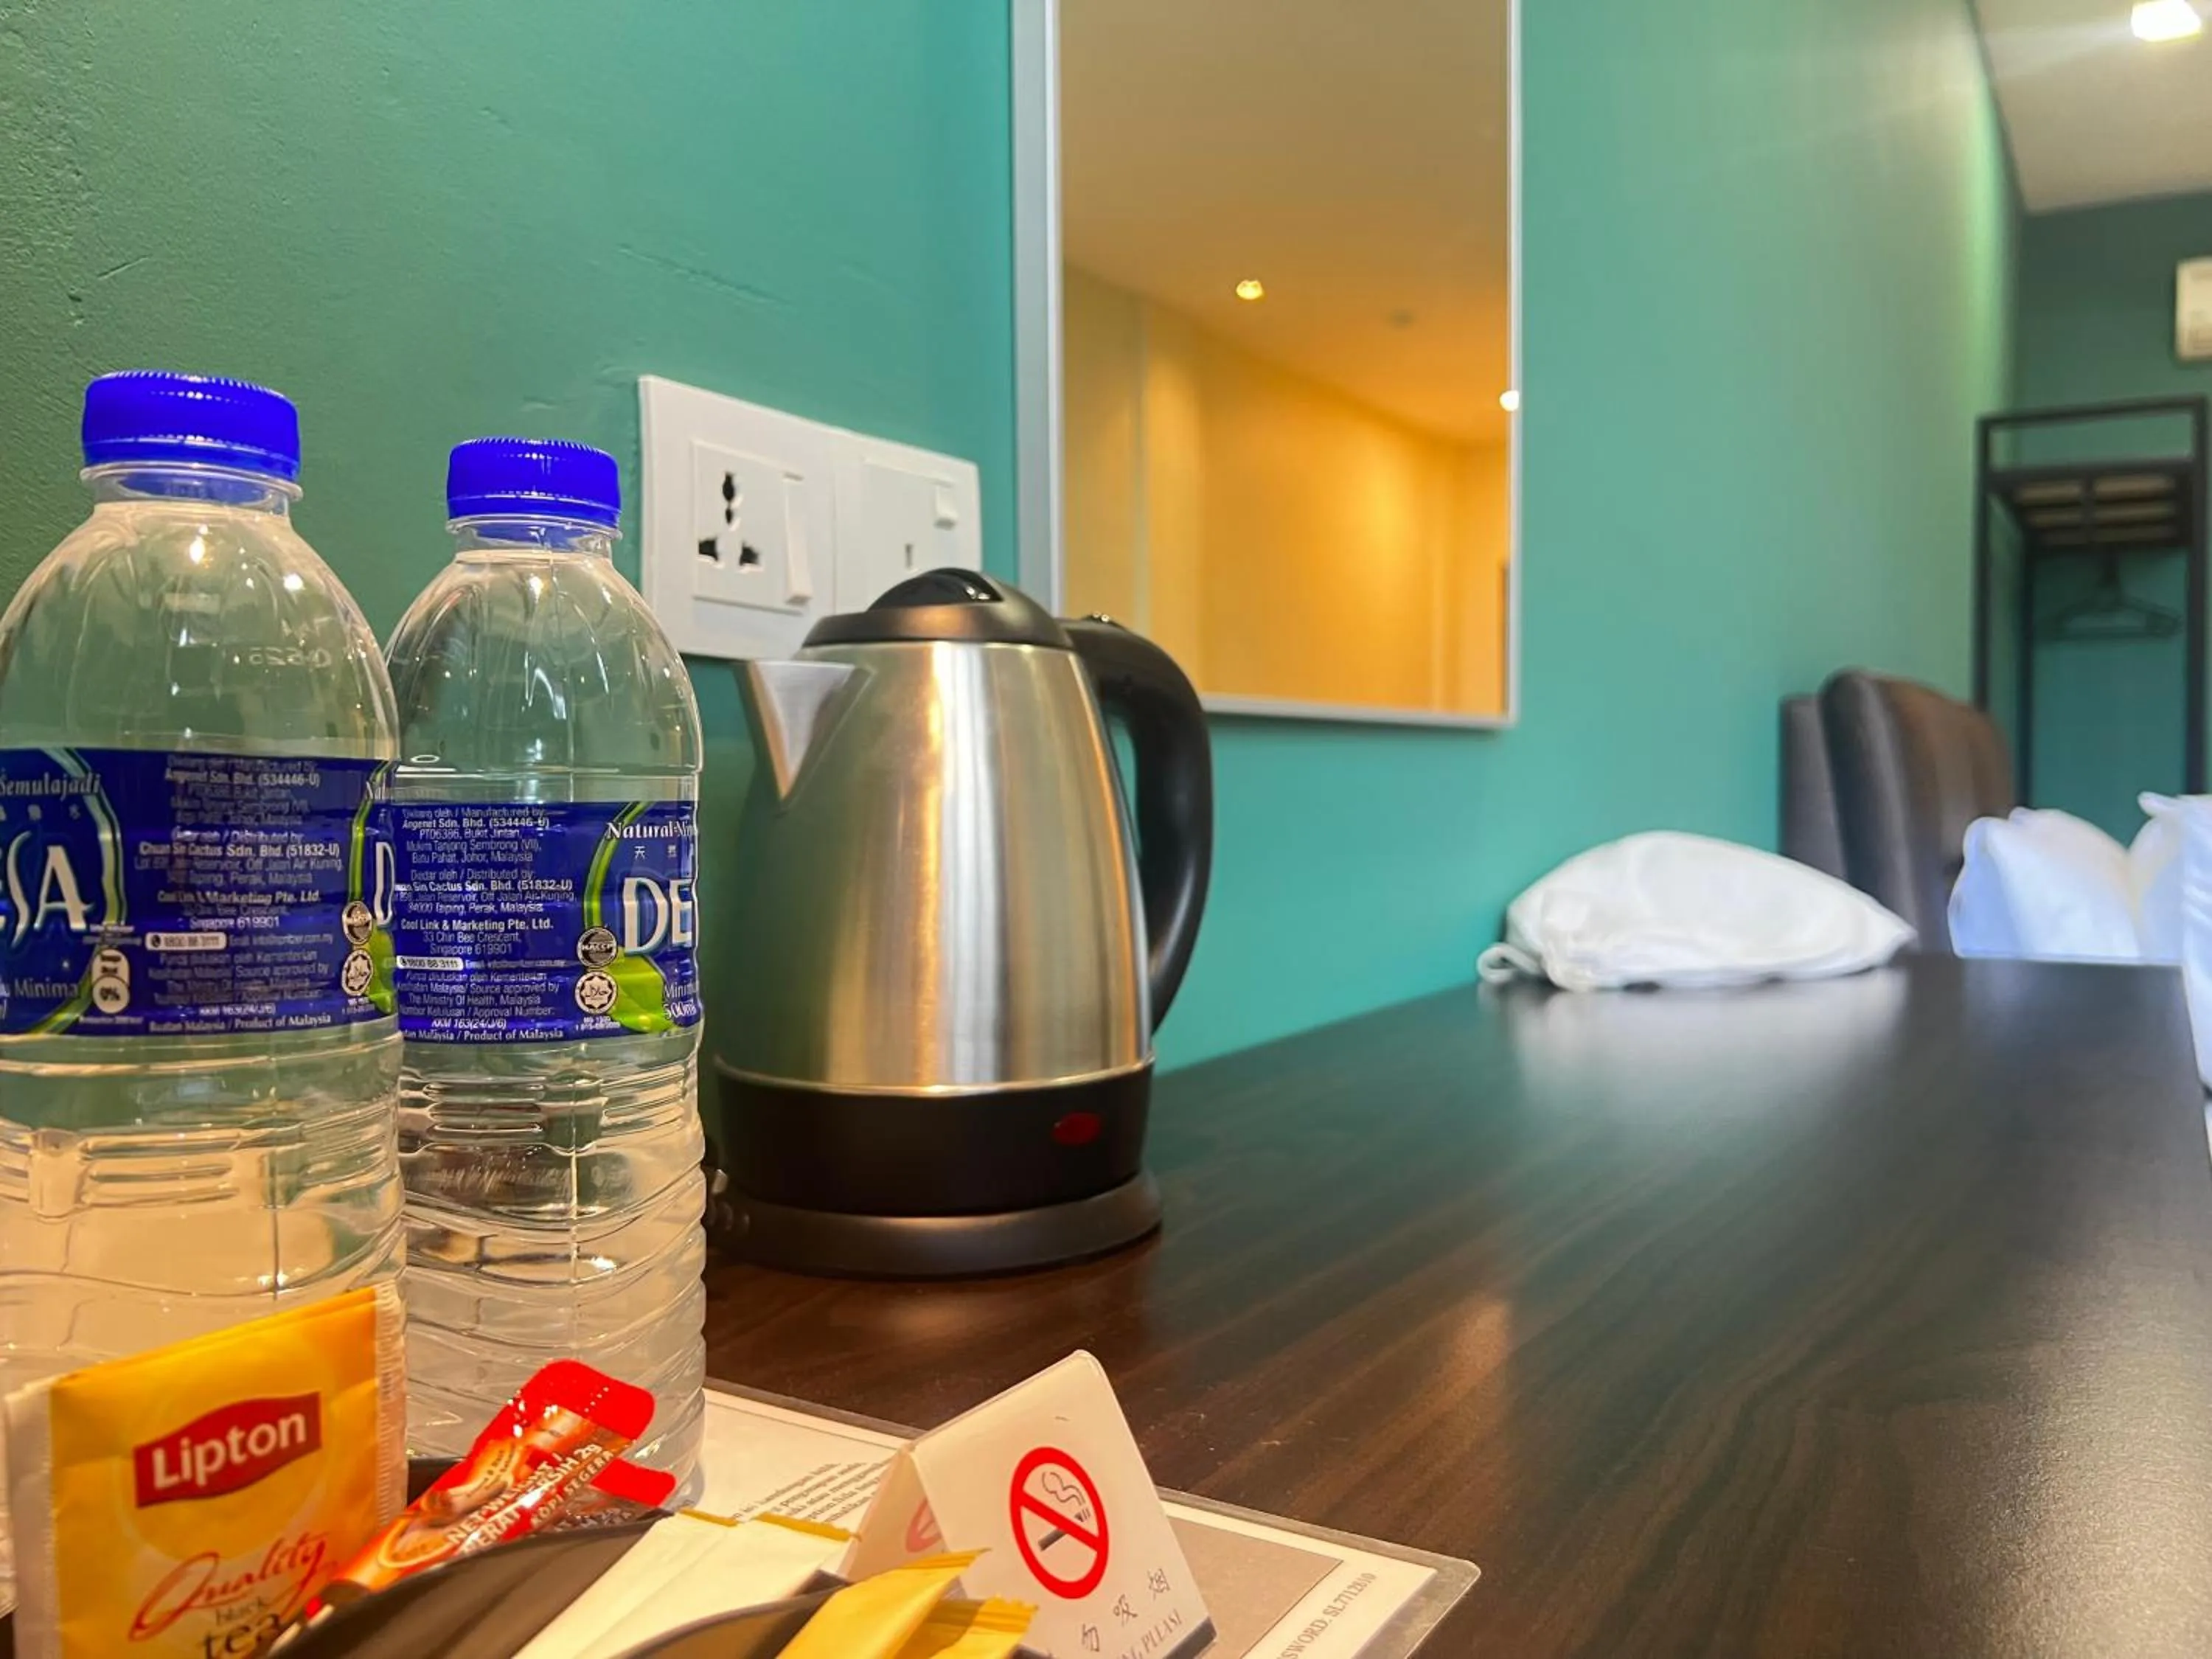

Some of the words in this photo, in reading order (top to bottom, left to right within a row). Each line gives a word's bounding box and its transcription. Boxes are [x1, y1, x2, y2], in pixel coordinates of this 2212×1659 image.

[403, 818, 437, 830] Angenet
[439, 818, 460, 828] Sdn.
[462, 817, 486, 827] Bhd.
[606, 821, 673, 838] Natural
[226, 844, 254, 856] Sdn.
[260, 844, 283, 856] Bhd.
[286, 843, 340, 859] (51832-U)
[470, 840, 518, 852] Sembrong
[461, 852, 489, 863] Johor,
[491, 852, 533, 863] Malaysia
[467, 869, 518, 880] Distributed
[0, 831, 93, 949] SA
[429, 881, 462, 891] Cactus
[465, 880, 486, 891] Sdn.
[490, 880, 515, 891] Bhd.
[518, 880, 573, 891] (51832-U)
[301, 891, 321, 902] Ltd.
[470, 902, 498, 914] Perak,
[501, 902, 543, 914] Malaysia
[401, 918, 418, 930] Cool
[420, 919, 439, 930] Link
[442, 919, 450, 930] &
[452, 919, 505, 932] Marketing
[507, 919, 529, 930] Pte.
[532, 918, 554, 930] Ltd.
[423, 932, 434, 942] 33
[436, 931, 454, 942] Chin
[457, 931, 476, 942] Bee
[477, 931, 522, 943] Crescent,
[430, 944, 473, 956] Singapore
[475, 943, 512, 954] 619901
[235, 966, 268, 977] Source
[471, 983, 503, 993] Source
[504, 983, 546, 994] approved
[548, 982, 560, 994] by
[467, 995, 498, 1005] Health,
[500, 994, 540, 1006] Malaysia
[473, 1006, 512, 1017] Approval
[515, 1006, 555, 1015] Number:
[235, 1017, 273, 1029] Product
[275, 1016, 286, 1026] of
[288, 1014, 331, 1026] Malaysia
[418, 1029, 454, 1040] Malaysia
[464, 1030, 502, 1040] Product
[505, 1030, 518, 1039] of
[519, 1028, 563, 1039] Malaysia
[151, 1412, 307, 1489] Lipton
[530, 1493, 564, 1528] KOPI
[563, 1450, 614, 1496] SEGERA
[446, 1510, 485, 1544] NET
[128, 1531, 329, 1643] Quality
[200, 1613, 282, 1659] tea
